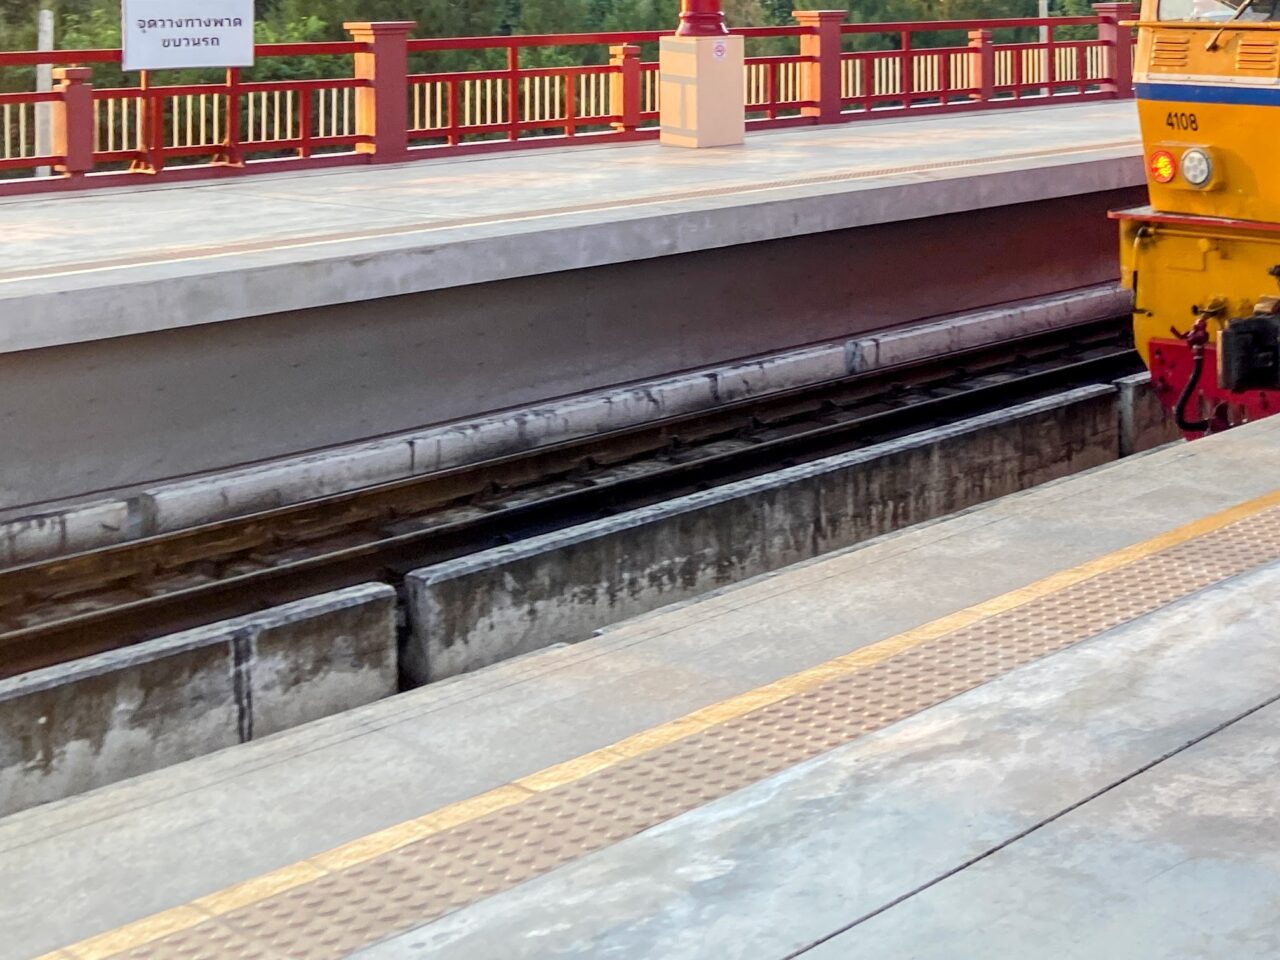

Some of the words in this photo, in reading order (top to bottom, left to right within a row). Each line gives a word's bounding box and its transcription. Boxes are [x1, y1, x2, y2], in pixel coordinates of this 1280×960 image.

[137, 17, 242, 33] จุดวางทางพาด
[162, 37, 220, 48] ขบวนรถ
[1166, 112, 1198, 131] 4108
